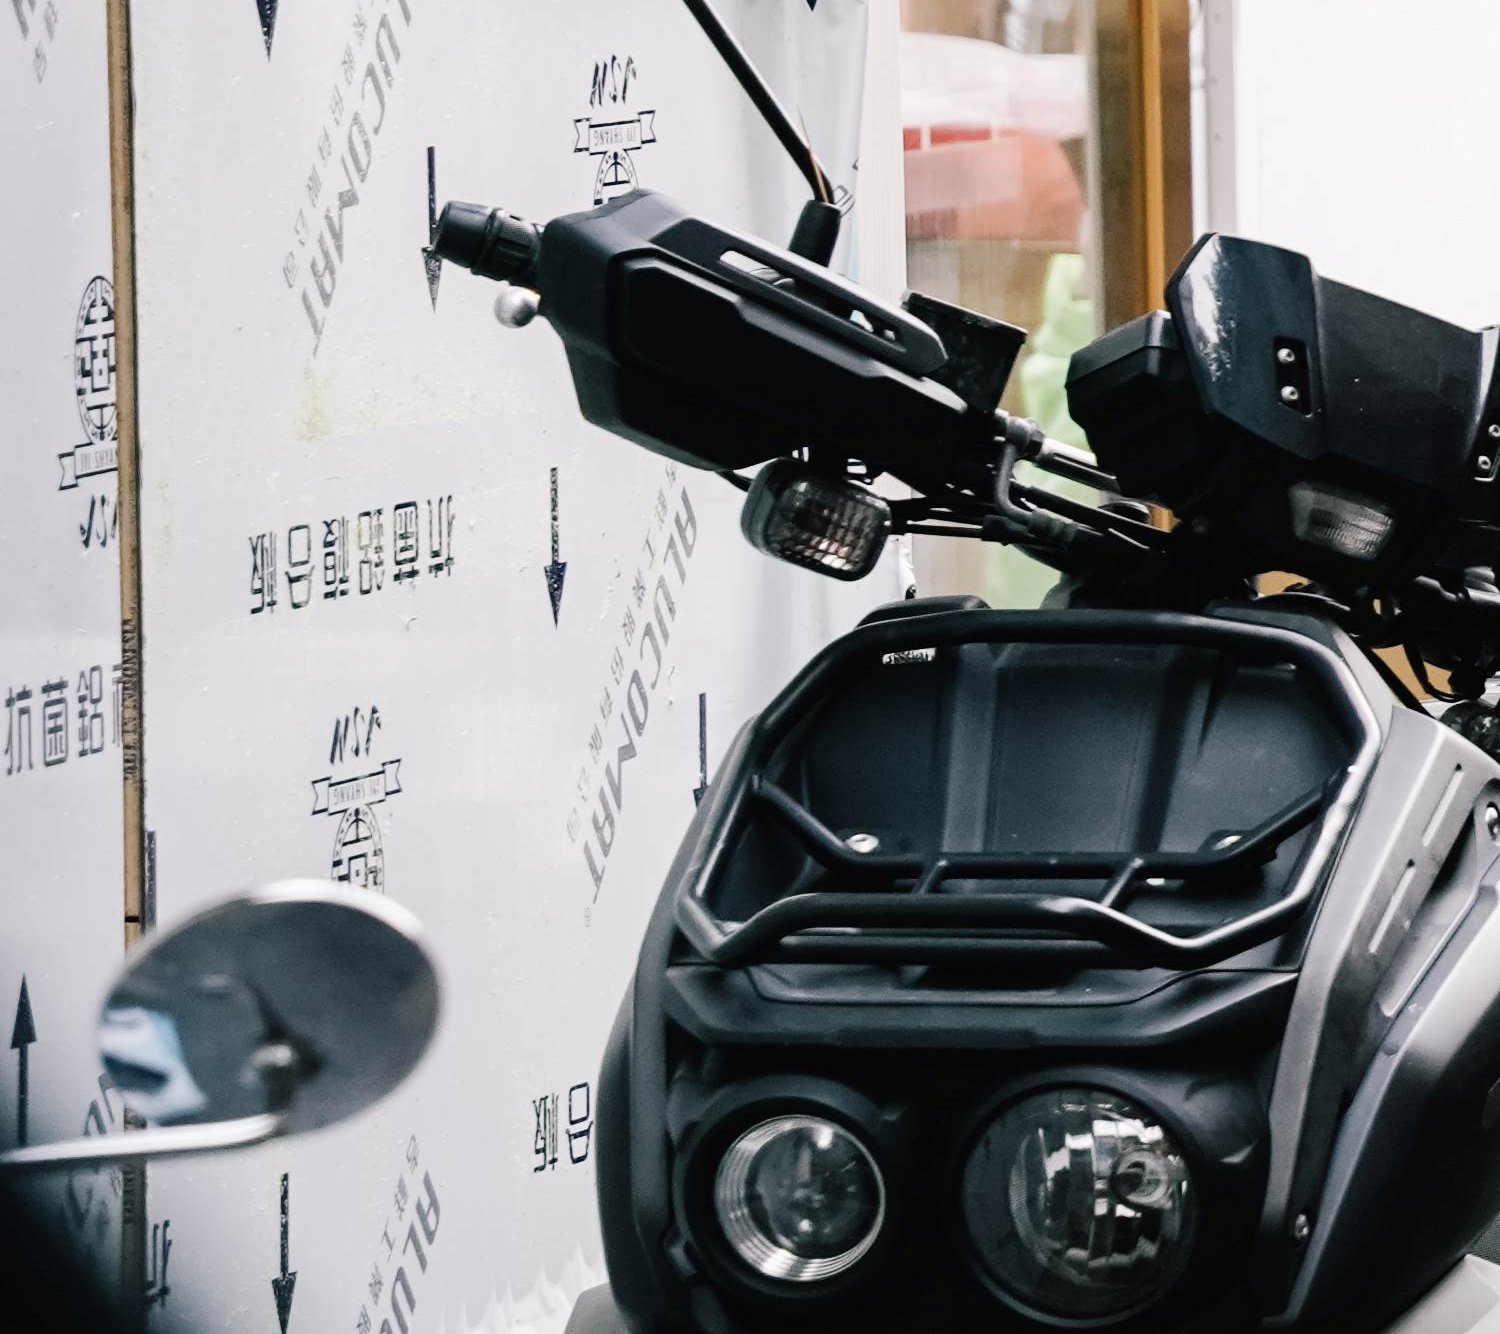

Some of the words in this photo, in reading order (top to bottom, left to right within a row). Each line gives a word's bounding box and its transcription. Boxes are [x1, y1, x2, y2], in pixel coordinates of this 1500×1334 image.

[248, 495, 456, 614] 抗菌鋁複合板
[581, 485, 696, 903] ALUCOMAT
